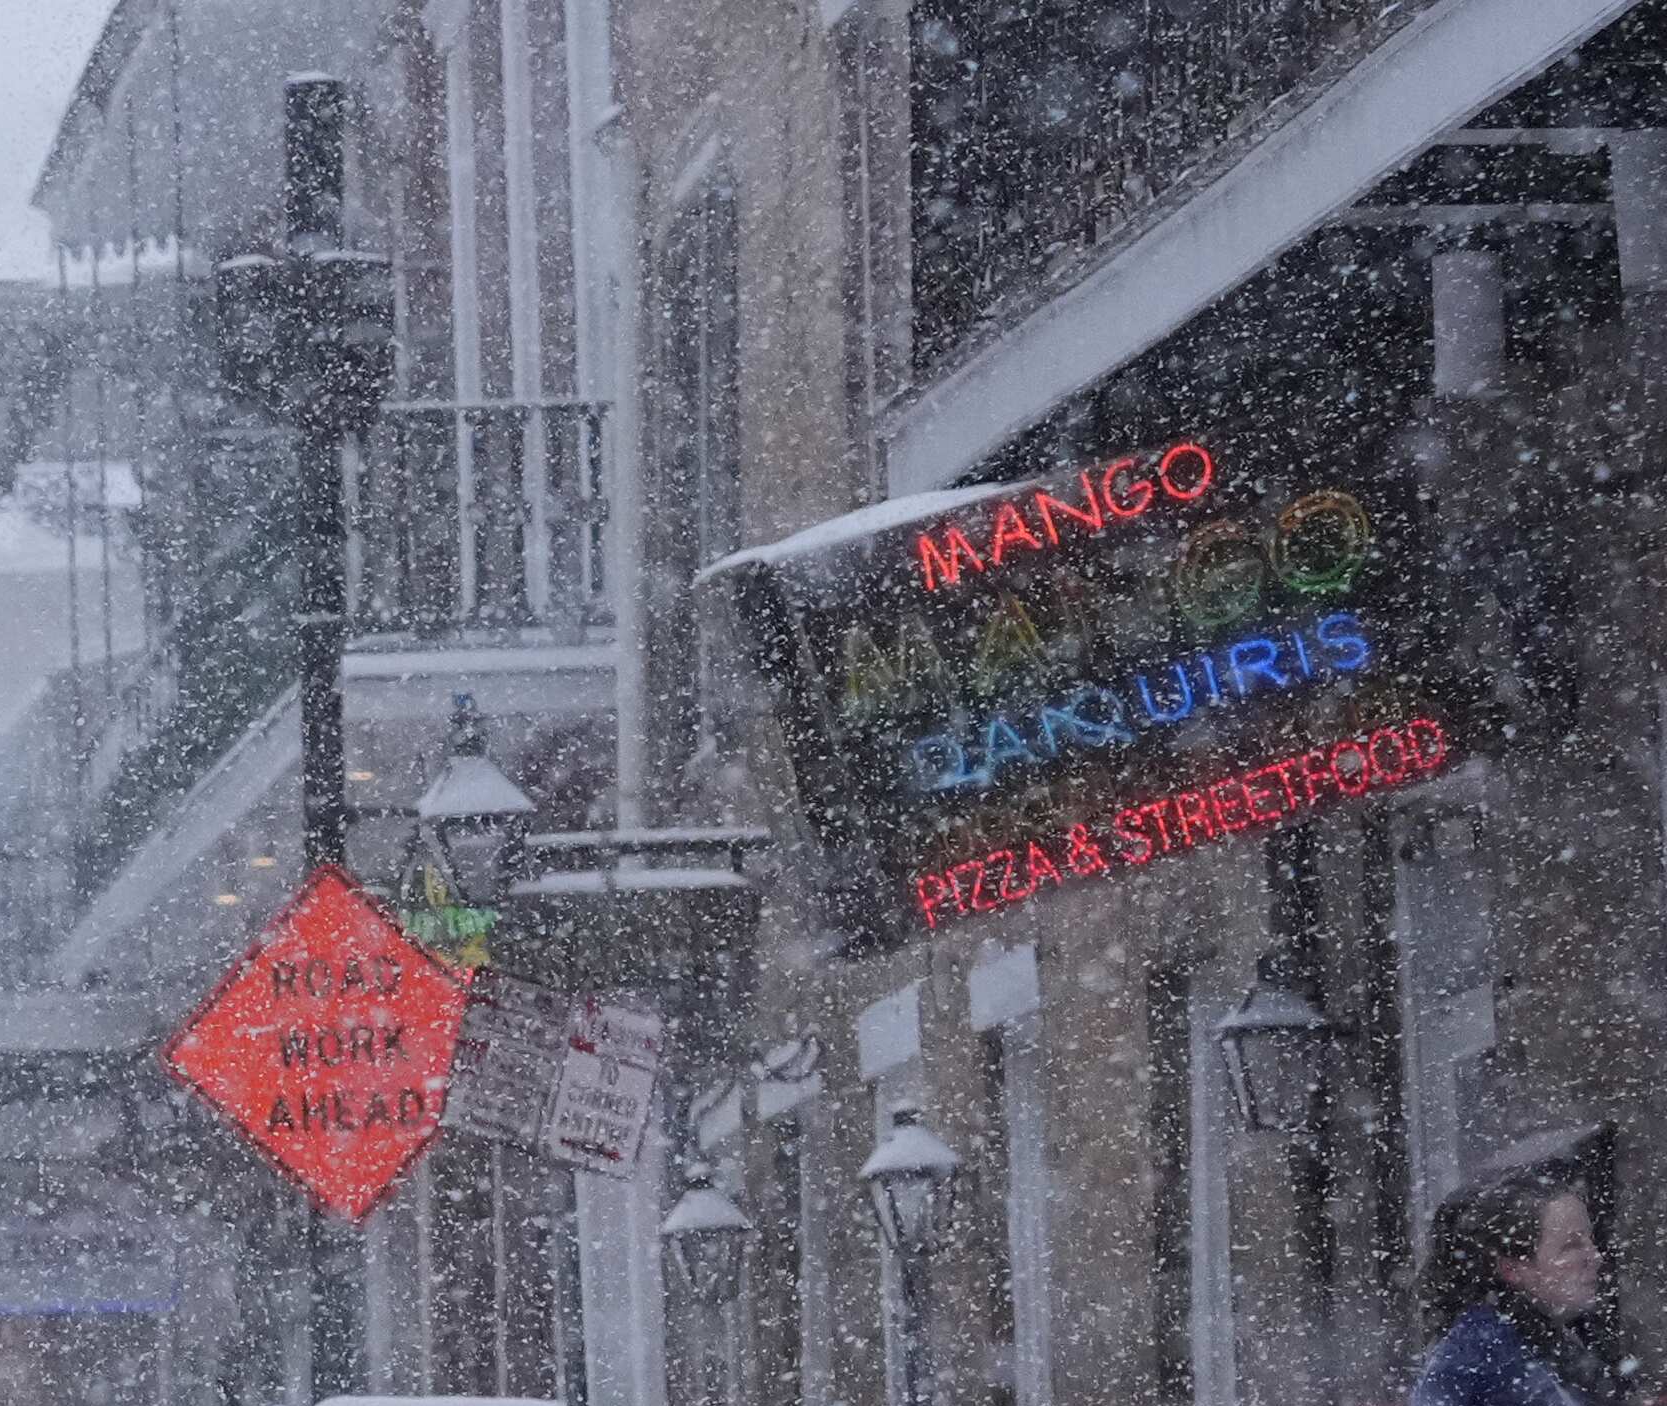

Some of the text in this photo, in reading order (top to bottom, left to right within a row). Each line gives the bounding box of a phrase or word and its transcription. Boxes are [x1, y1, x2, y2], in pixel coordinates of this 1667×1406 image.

[916, 441, 1216, 592] MANGO
[917, 839, 1063, 928] PIZZA
[272, 956, 403, 997] ROAD
[280, 1024, 410, 1068] WORK
[269, 1088, 425, 1132] AHEAD
